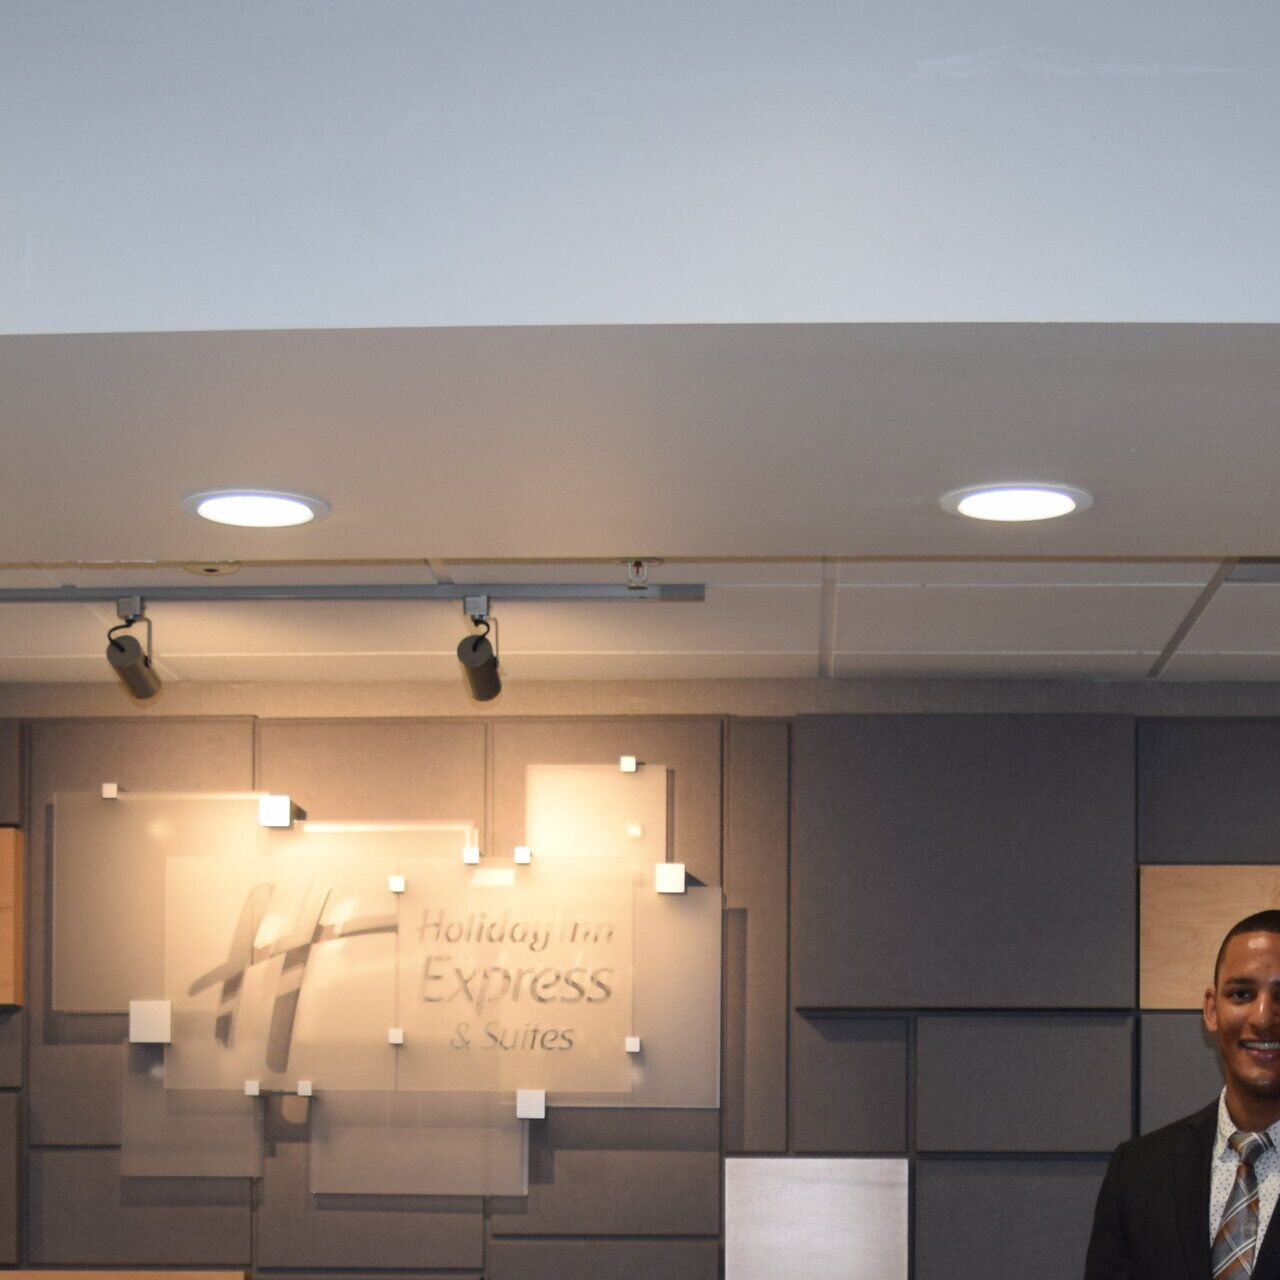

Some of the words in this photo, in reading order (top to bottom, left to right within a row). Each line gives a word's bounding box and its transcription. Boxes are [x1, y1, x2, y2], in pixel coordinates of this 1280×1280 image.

[417, 909, 550, 952] Holiday
[558, 911, 614, 943] Inn
[421, 956, 615, 1016] Express
[449, 1022, 472, 1050] &
[480, 1021, 576, 1050] Suites
